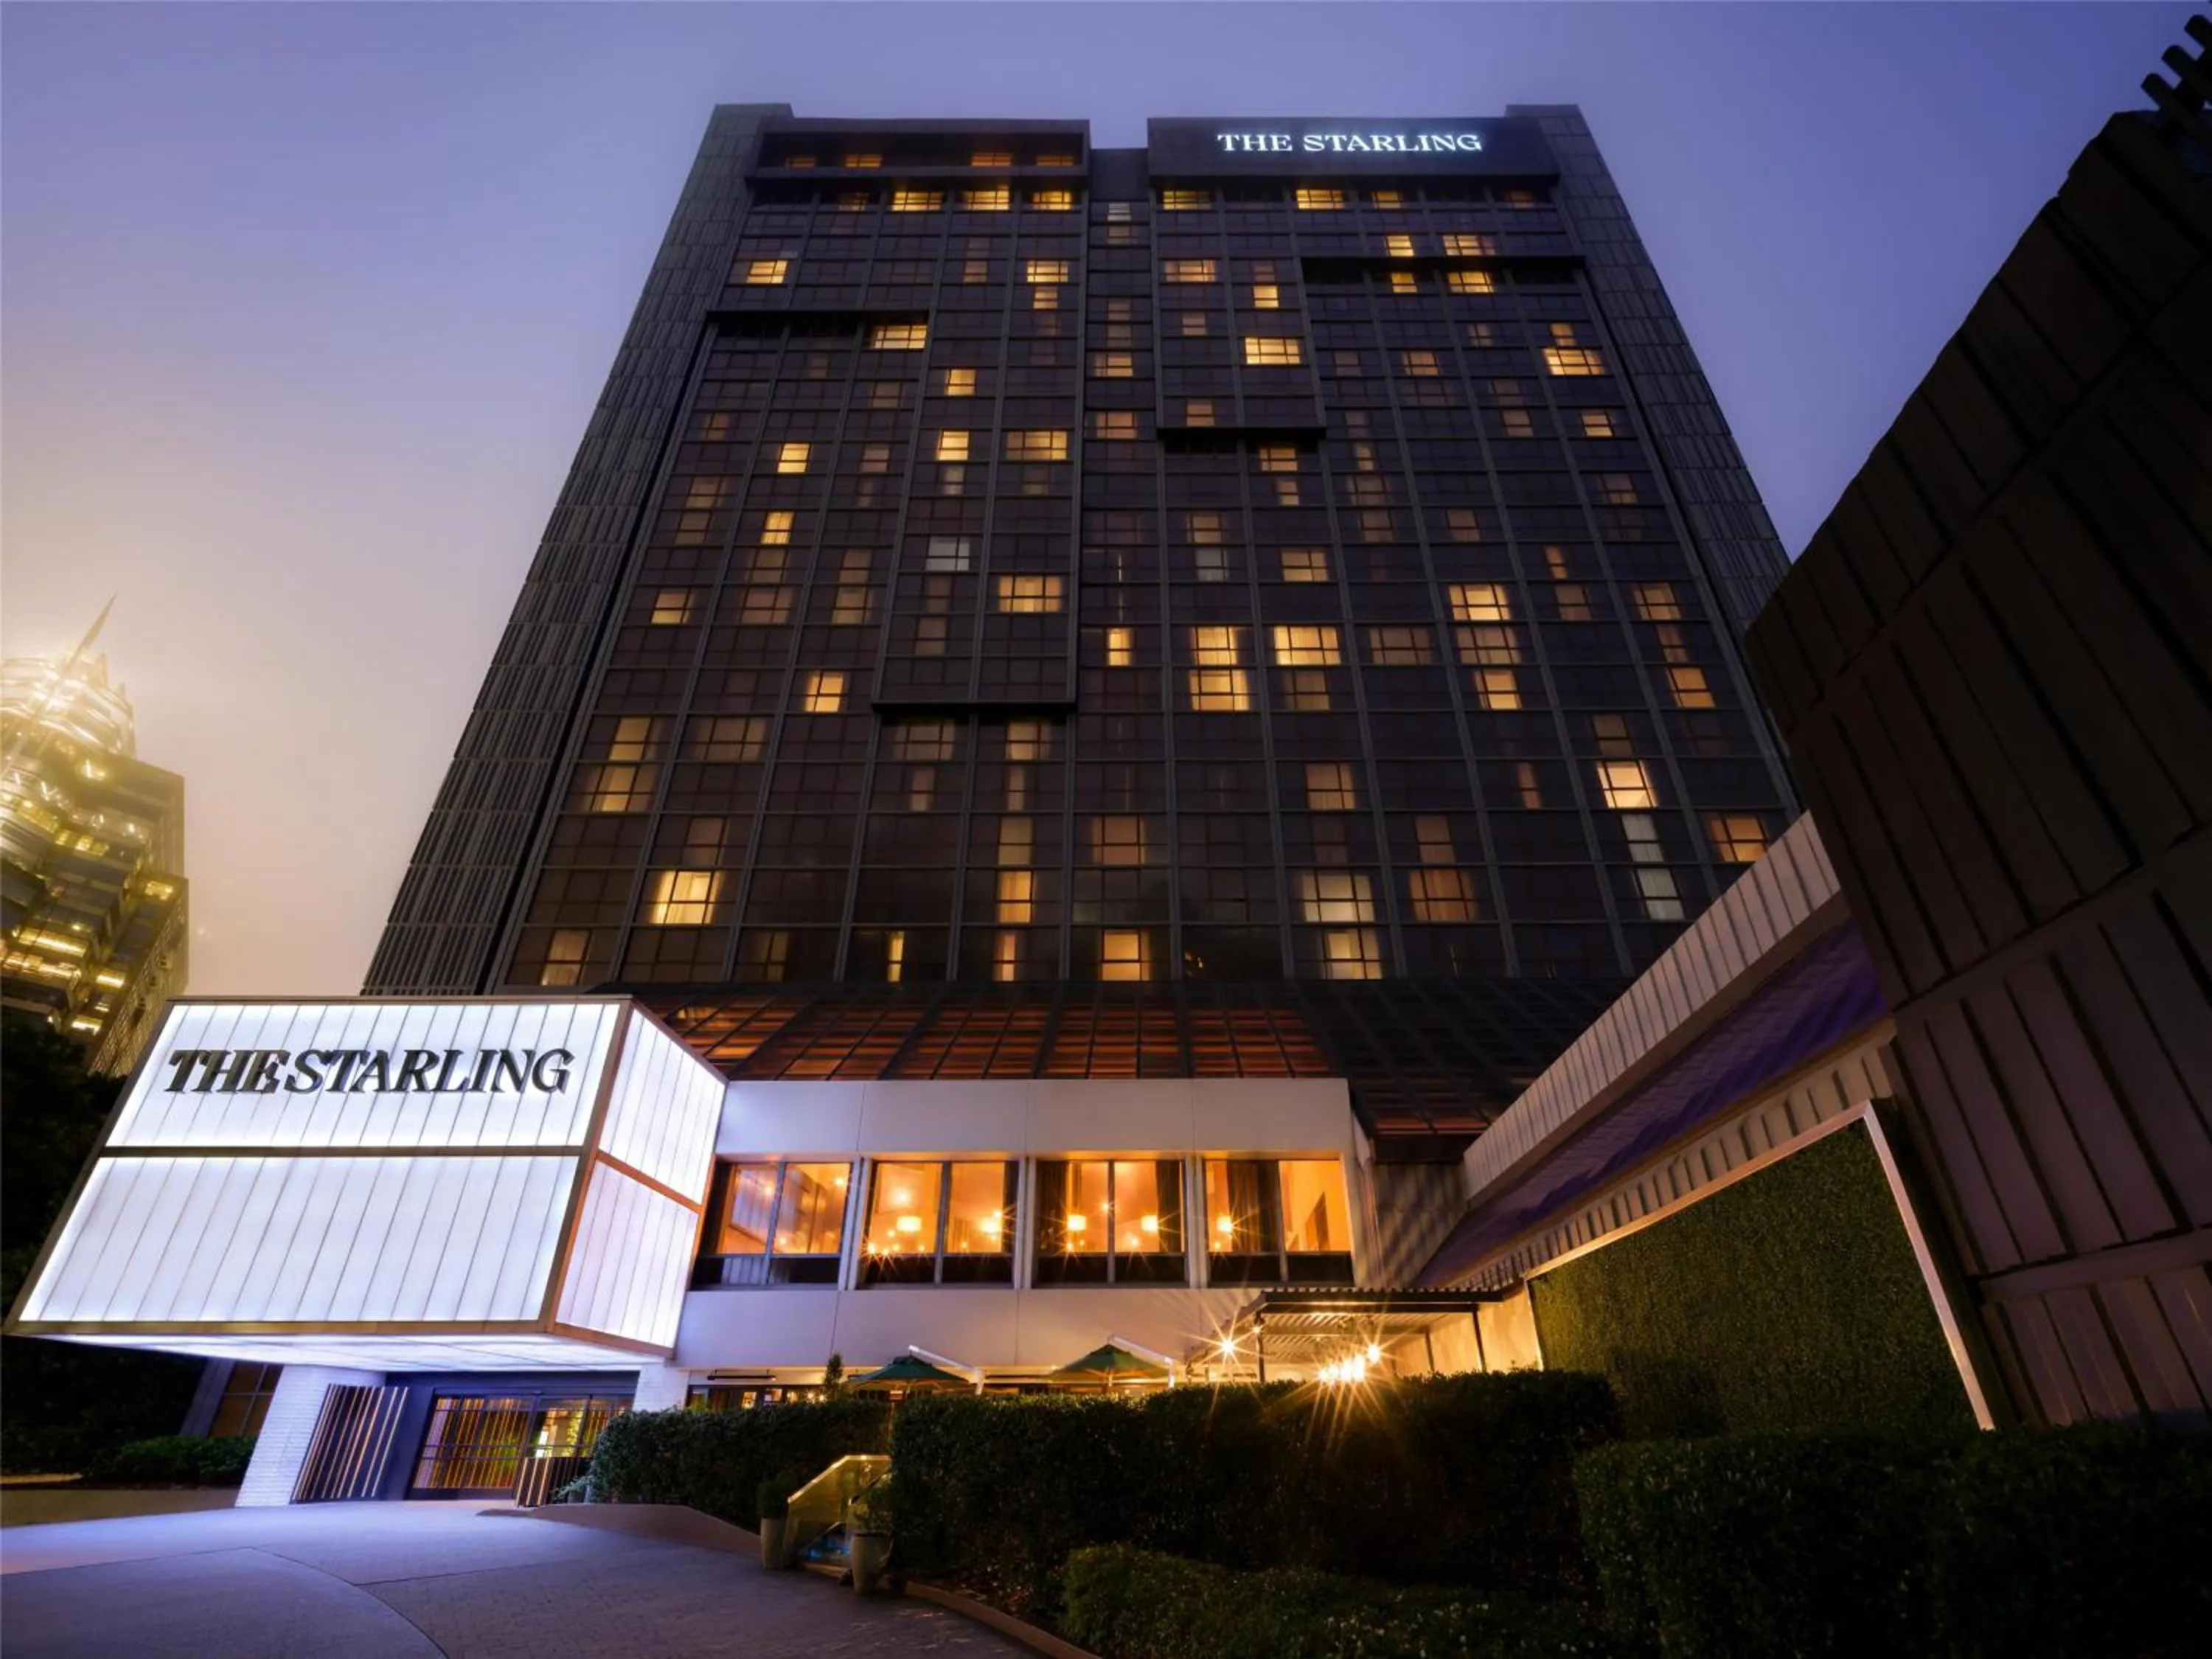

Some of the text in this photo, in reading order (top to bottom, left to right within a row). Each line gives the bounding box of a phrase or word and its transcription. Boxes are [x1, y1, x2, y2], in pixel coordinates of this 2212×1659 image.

[1217, 133, 1483, 152] THE STARLING
[164, 1048, 575, 1095] THE STARLING
